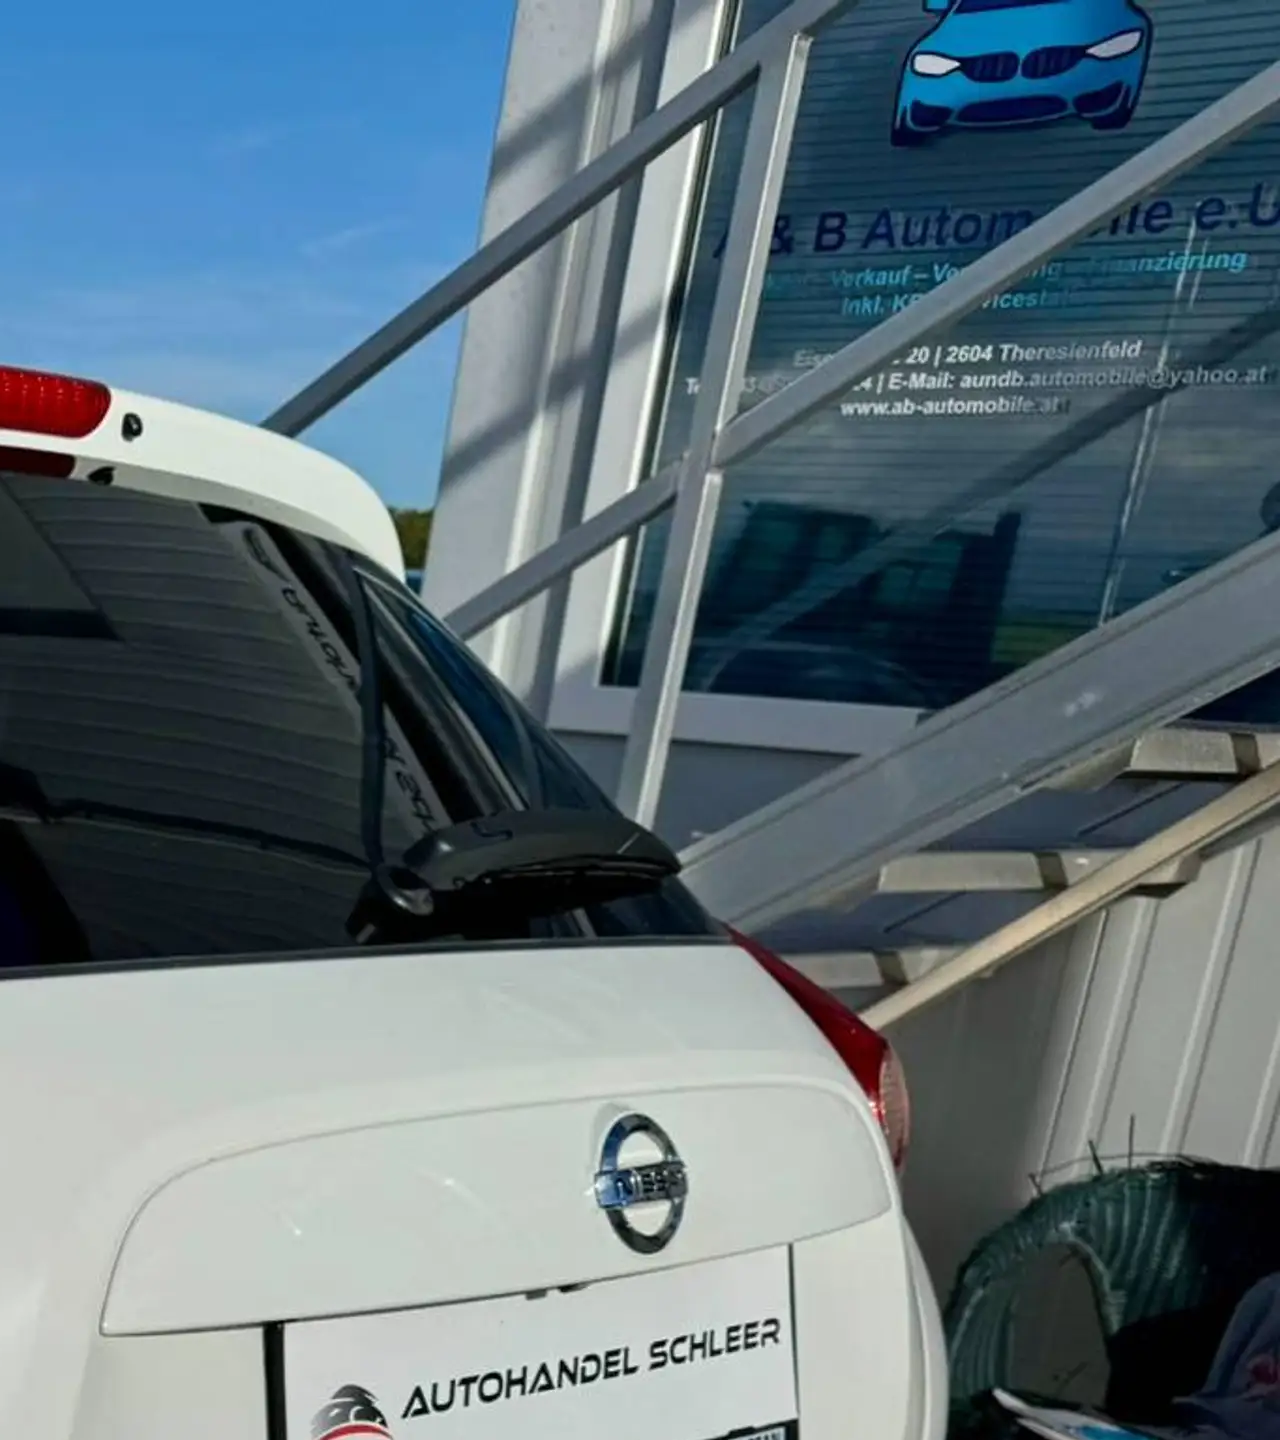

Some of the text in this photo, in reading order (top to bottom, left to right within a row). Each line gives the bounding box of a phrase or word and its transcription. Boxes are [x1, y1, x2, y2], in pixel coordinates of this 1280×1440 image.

[813, 211, 848, 252] B
[860, 200, 1173, 249] Automile
[832, 264, 912, 287] Verkauf
[906, 346, 930, 364] 20
[946, 344, 993, 364] 2604
[999, 340, 1143, 363] Theresienfeld
[888, 371, 956, 391] E-Mail:
[959, 365, 1268, 390] aundb.automobile@yahoo.at
[840, 397, 1061, 416] www.ab-automobile.at
[401, 1317, 782, 1419] AUTOHANDEL SCHLEER
